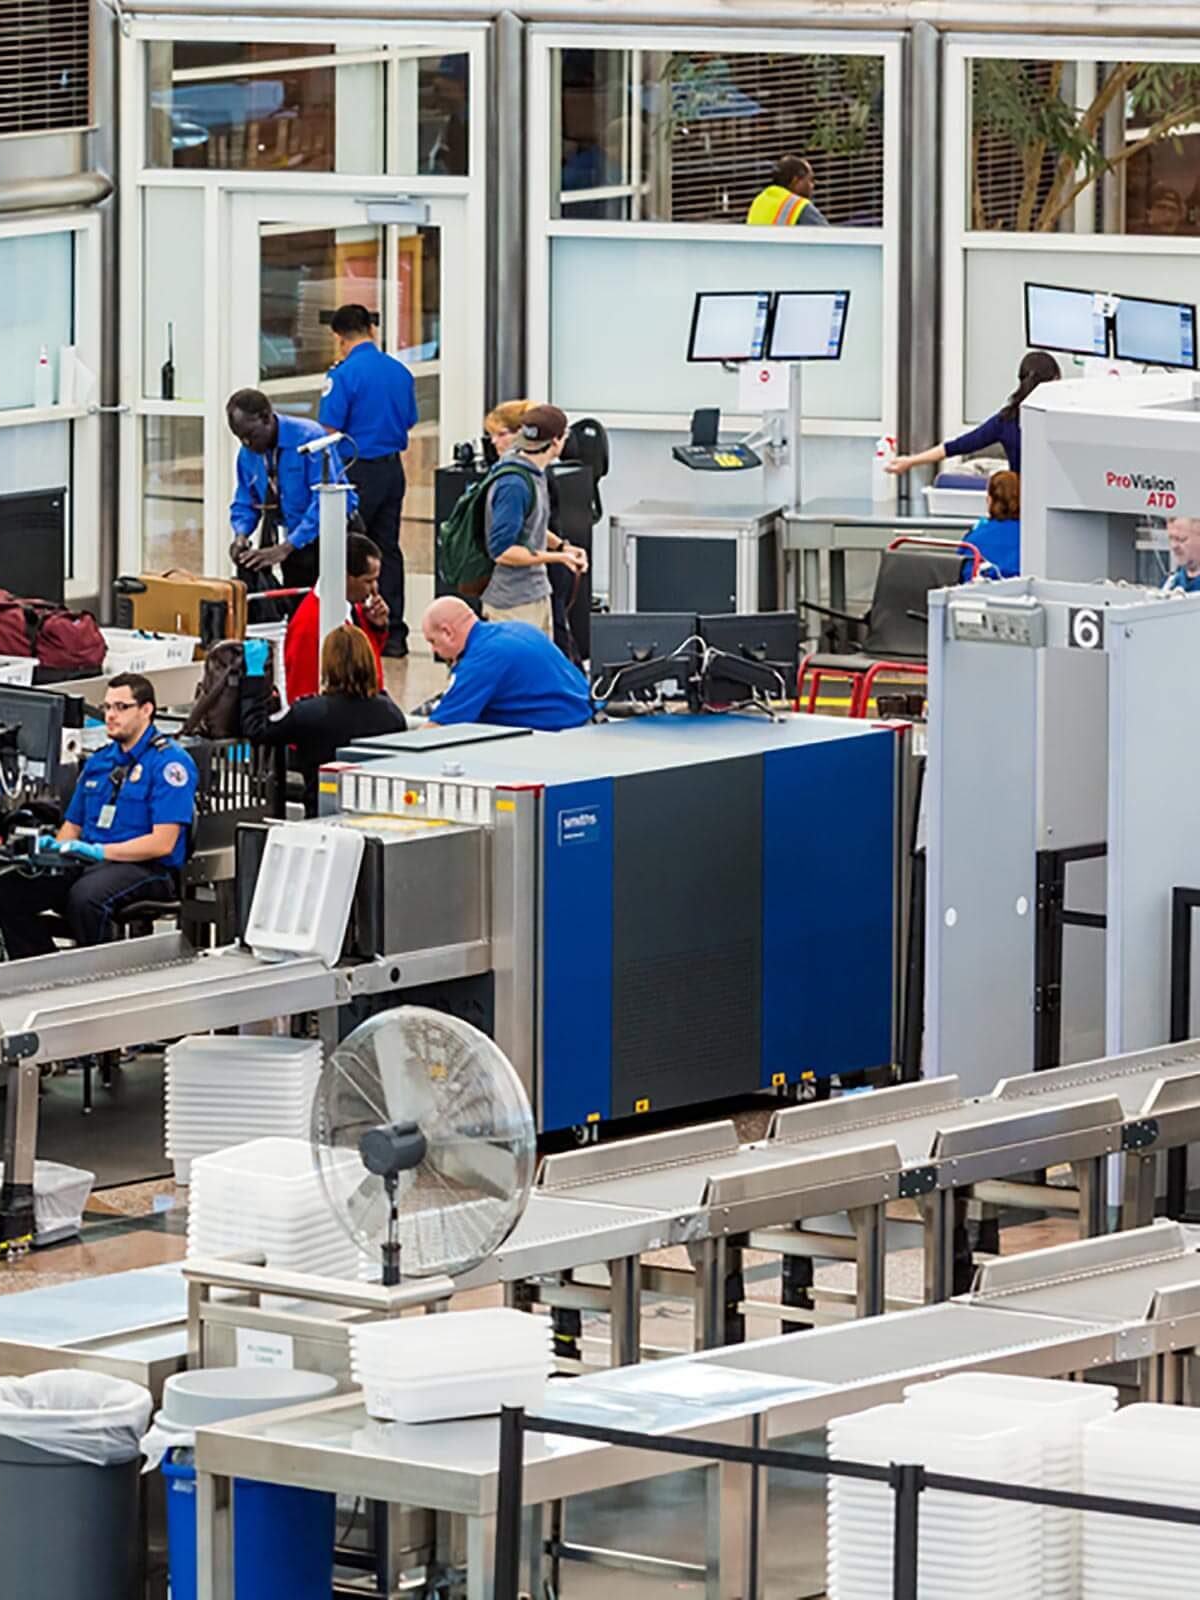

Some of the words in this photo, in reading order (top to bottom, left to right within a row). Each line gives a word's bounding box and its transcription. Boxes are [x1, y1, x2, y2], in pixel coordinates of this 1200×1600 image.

[1105, 471, 1175, 491] ProVision
[1146, 492, 1177, 509] ATD
[1072, 609, 1100, 648] 6
